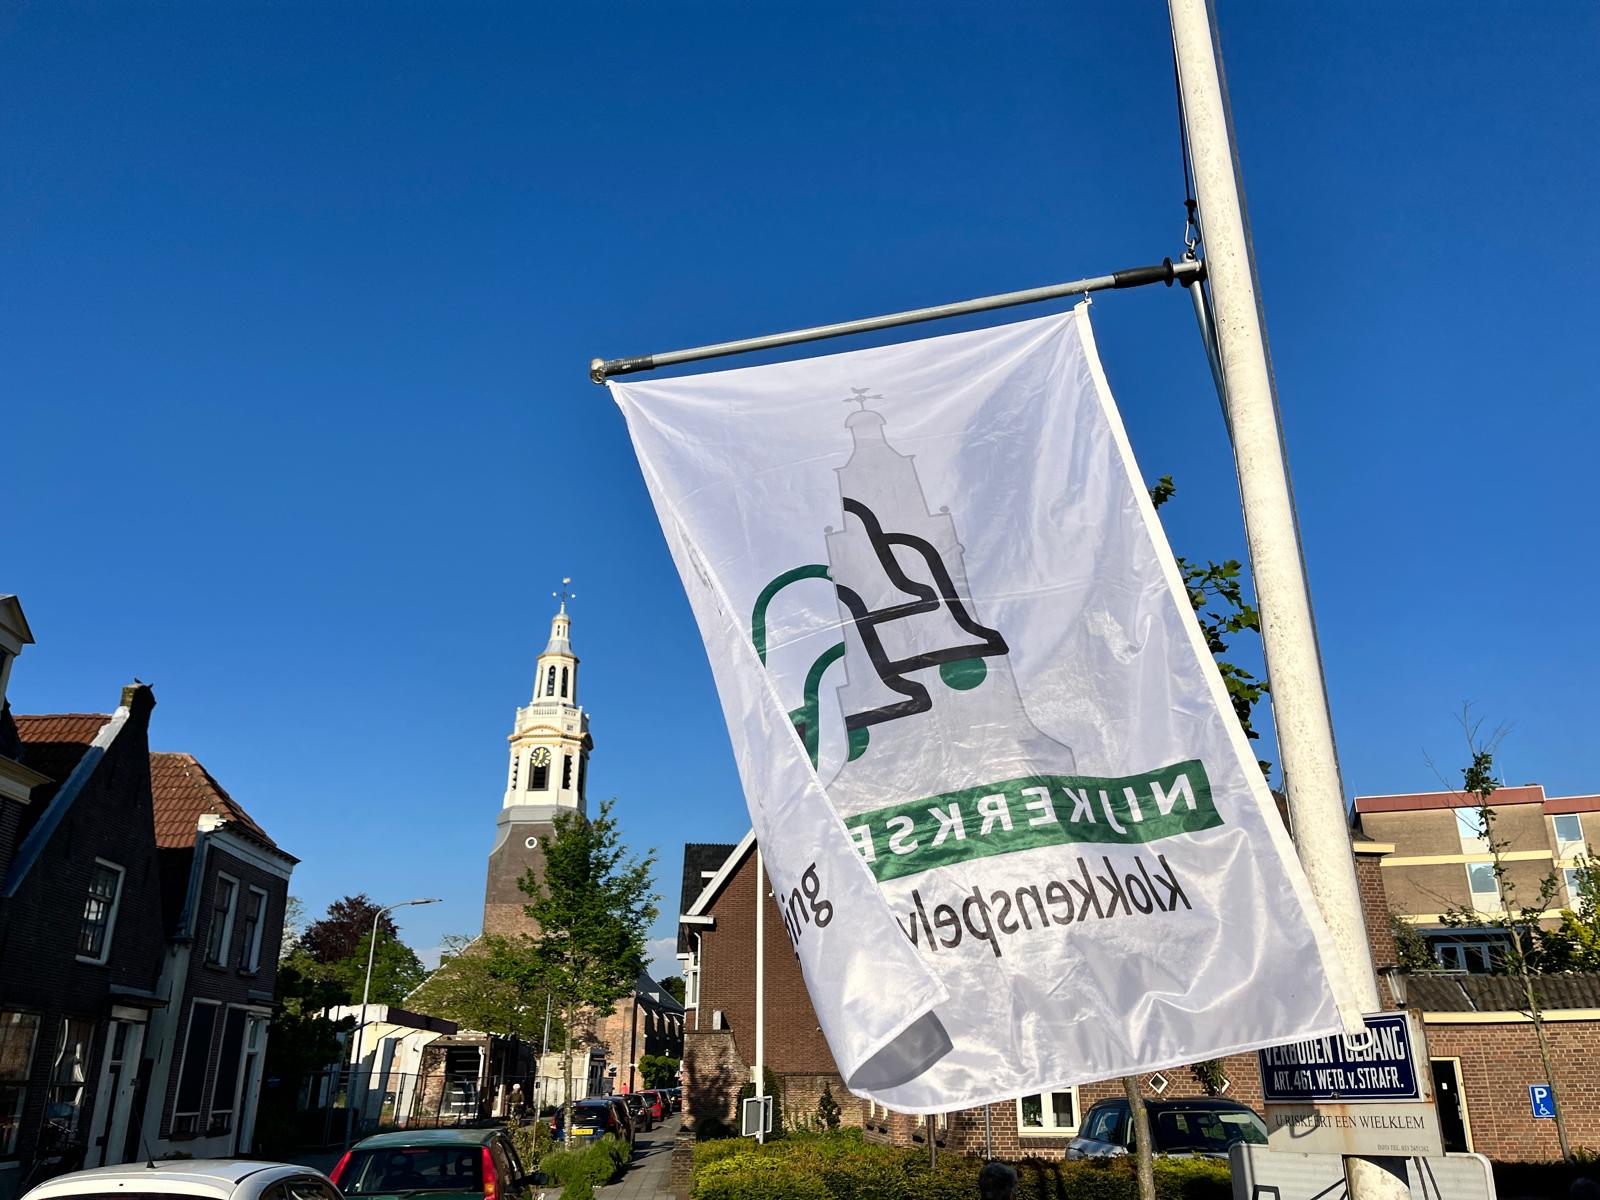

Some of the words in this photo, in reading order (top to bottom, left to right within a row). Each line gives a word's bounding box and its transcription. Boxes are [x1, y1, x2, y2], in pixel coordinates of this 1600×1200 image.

[781, 861, 834, 946] ing
[1274, 1071, 1293, 1091] ART.
[1294, 1070, 1316, 1091] 461.
[1315, 1069, 1348, 1090] WETB.
[1357, 1067, 1404, 1089] STRAFR.
[1534, 1088, 1547, 1104] P
[1285, 1115, 1333, 1128] RISKEERT
[1336, 1115, 1357, 1128] EEN
[1360, 1116, 1425, 1129] WIELKLEM
